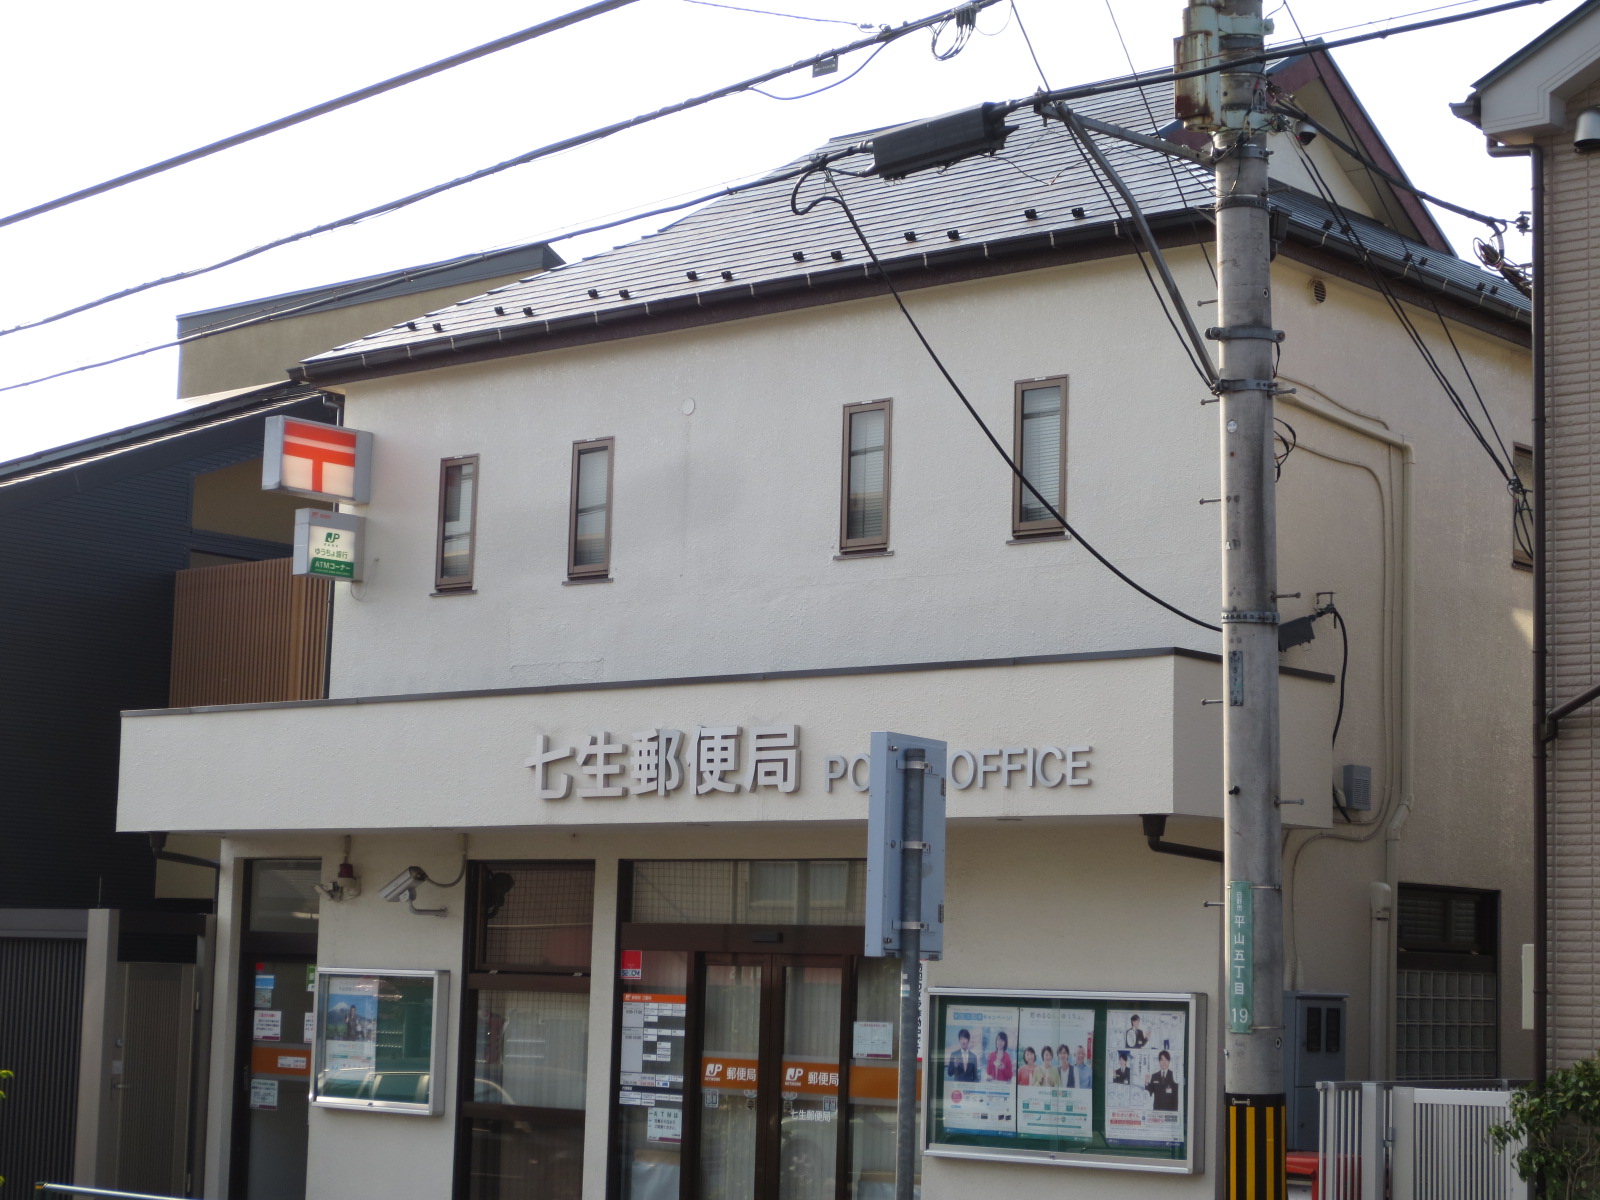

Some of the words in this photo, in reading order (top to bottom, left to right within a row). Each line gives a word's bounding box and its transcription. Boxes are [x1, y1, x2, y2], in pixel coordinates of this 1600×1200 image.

[325, 532, 340, 543] JP
[314, 548, 348, 560] ゆうちょ銀行
[314, 560, 351, 570] ATMコーナー
[525, 724, 800, 800] 七生郵便局
[824, 754, 870, 793] PO
[950, 745, 1093, 790] OFFICE
[1234, 915, 1245, 995] 平山五丁目
[1231, 1008, 1249, 1024] 19
[705, 1063, 722, 1077] JP
[726, 1067, 756, 1082] 郵便局
[785, 1068, 803, 1081] JP
[807, 1071, 839, 1087] 郵便局
[790, 1109, 831, 1123] 七生郵便局
